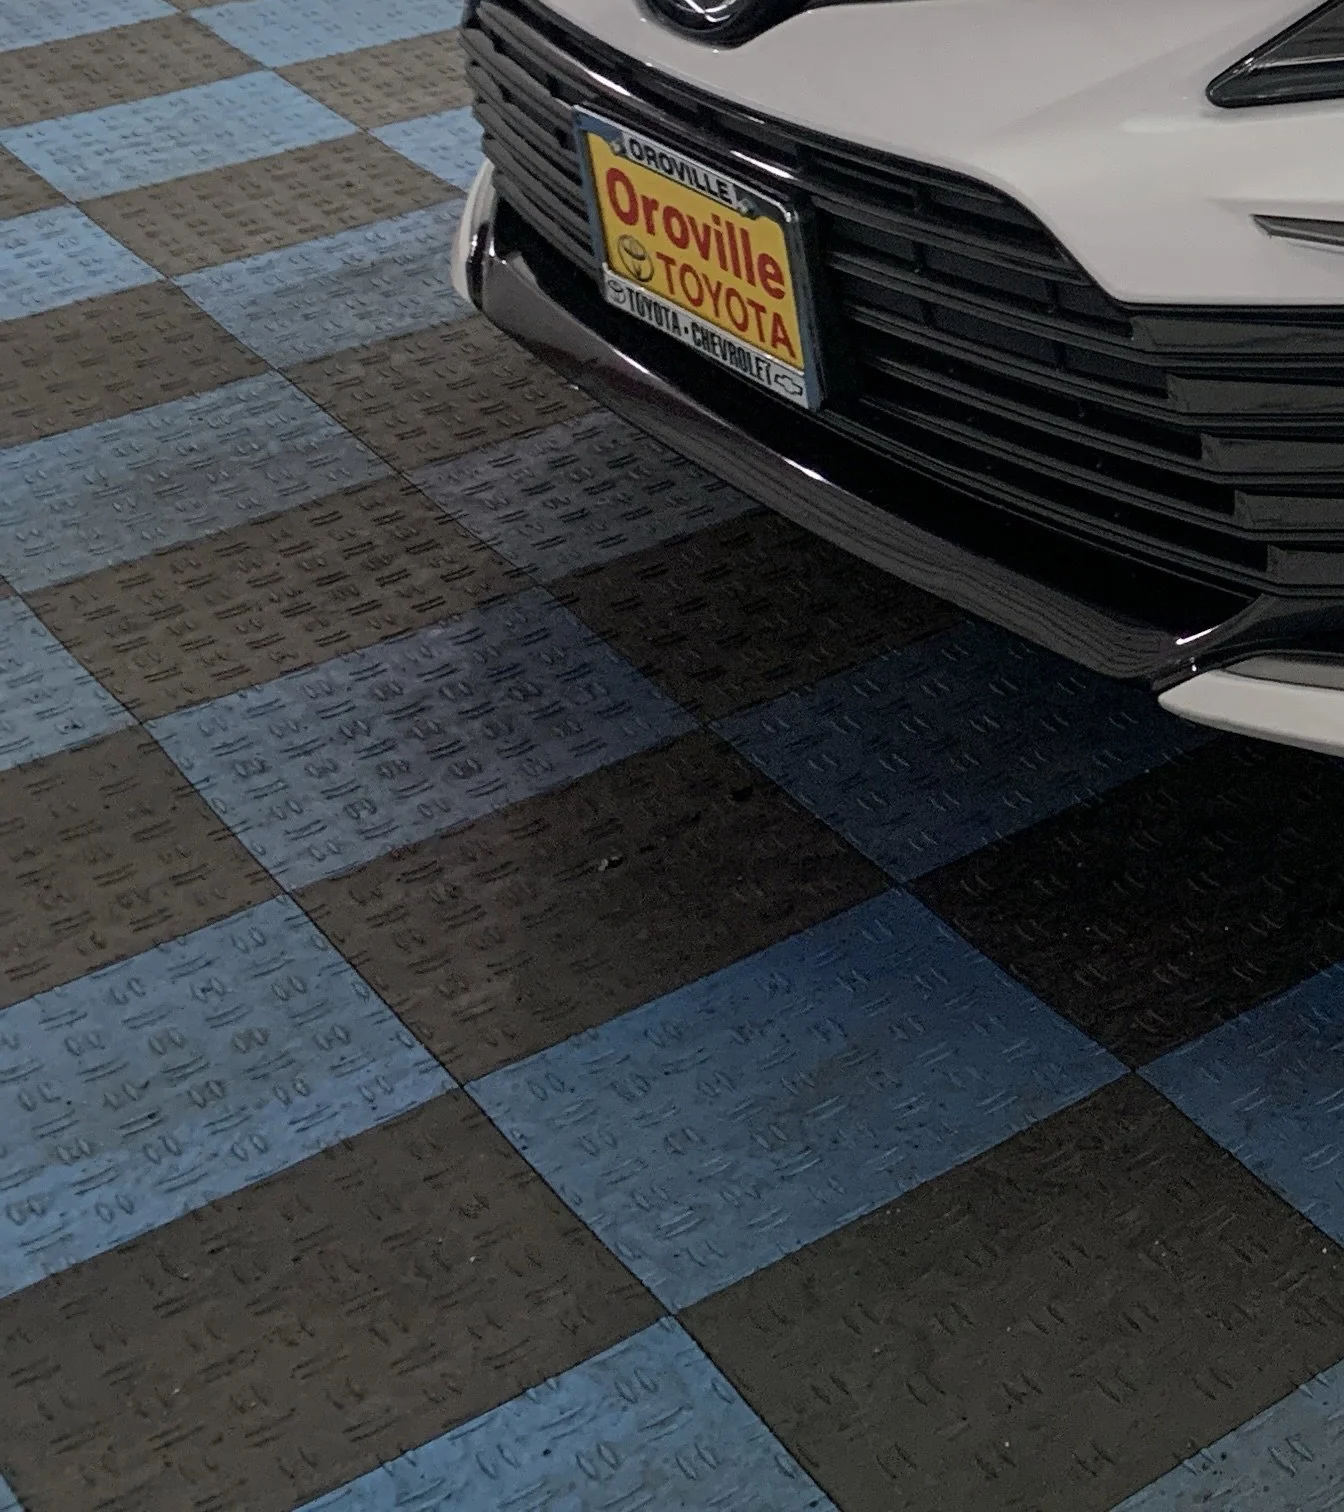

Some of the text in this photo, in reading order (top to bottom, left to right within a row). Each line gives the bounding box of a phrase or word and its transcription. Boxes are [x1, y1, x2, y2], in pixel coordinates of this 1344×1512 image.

[628, 137, 734, 204] OROVILLE
[605, 167, 786, 300] Oroville
[628, 286, 773, 387] TOYOTA CHEVROLET
[656, 251, 797, 359] TOYOTA
